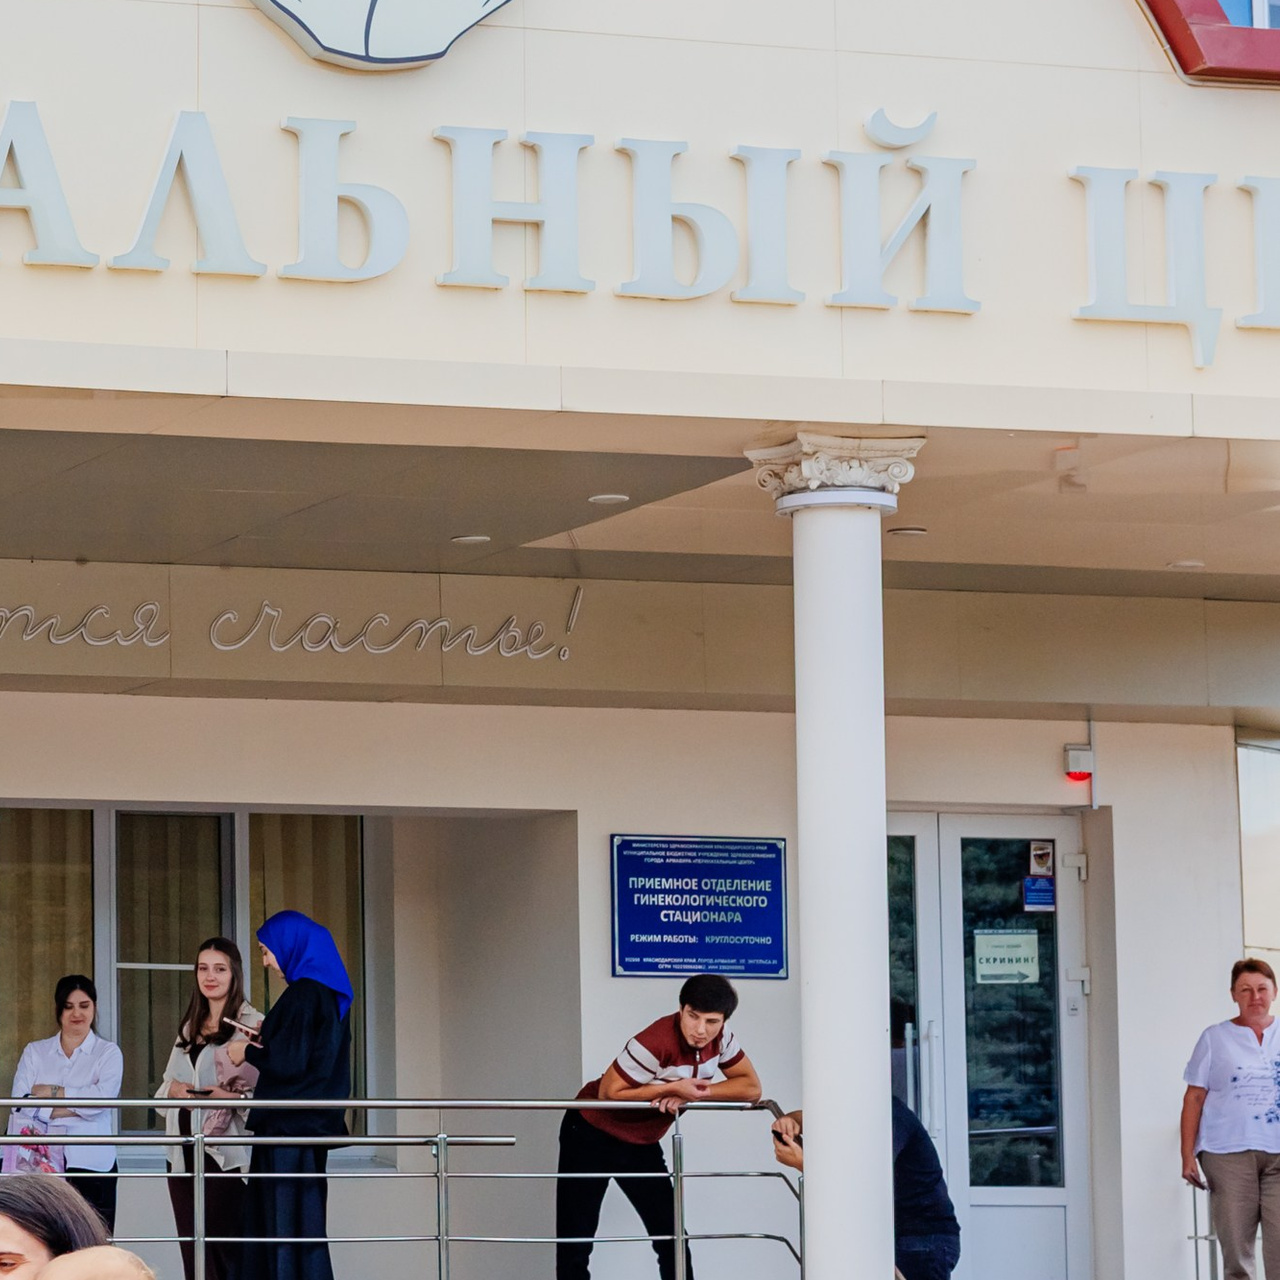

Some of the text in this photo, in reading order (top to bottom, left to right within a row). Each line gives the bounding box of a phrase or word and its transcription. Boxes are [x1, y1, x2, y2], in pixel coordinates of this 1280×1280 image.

[208, 584, 585, 661] счастье!
[628, 877, 772, 893] ПРИЕМНОЕ ОТДЕЛЕНИЕ
[634, 894, 768, 908] ГИНЕКОЛОГИЧЕСКОГО
[660, 910, 742, 924] СТАЦИОНАРА
[630, 934, 772, 945] РЕЖИМ РАБОТЫ: КРУГЛОСУТОЧНО
[978, 956, 1035, 965] СКРИНИНГ
